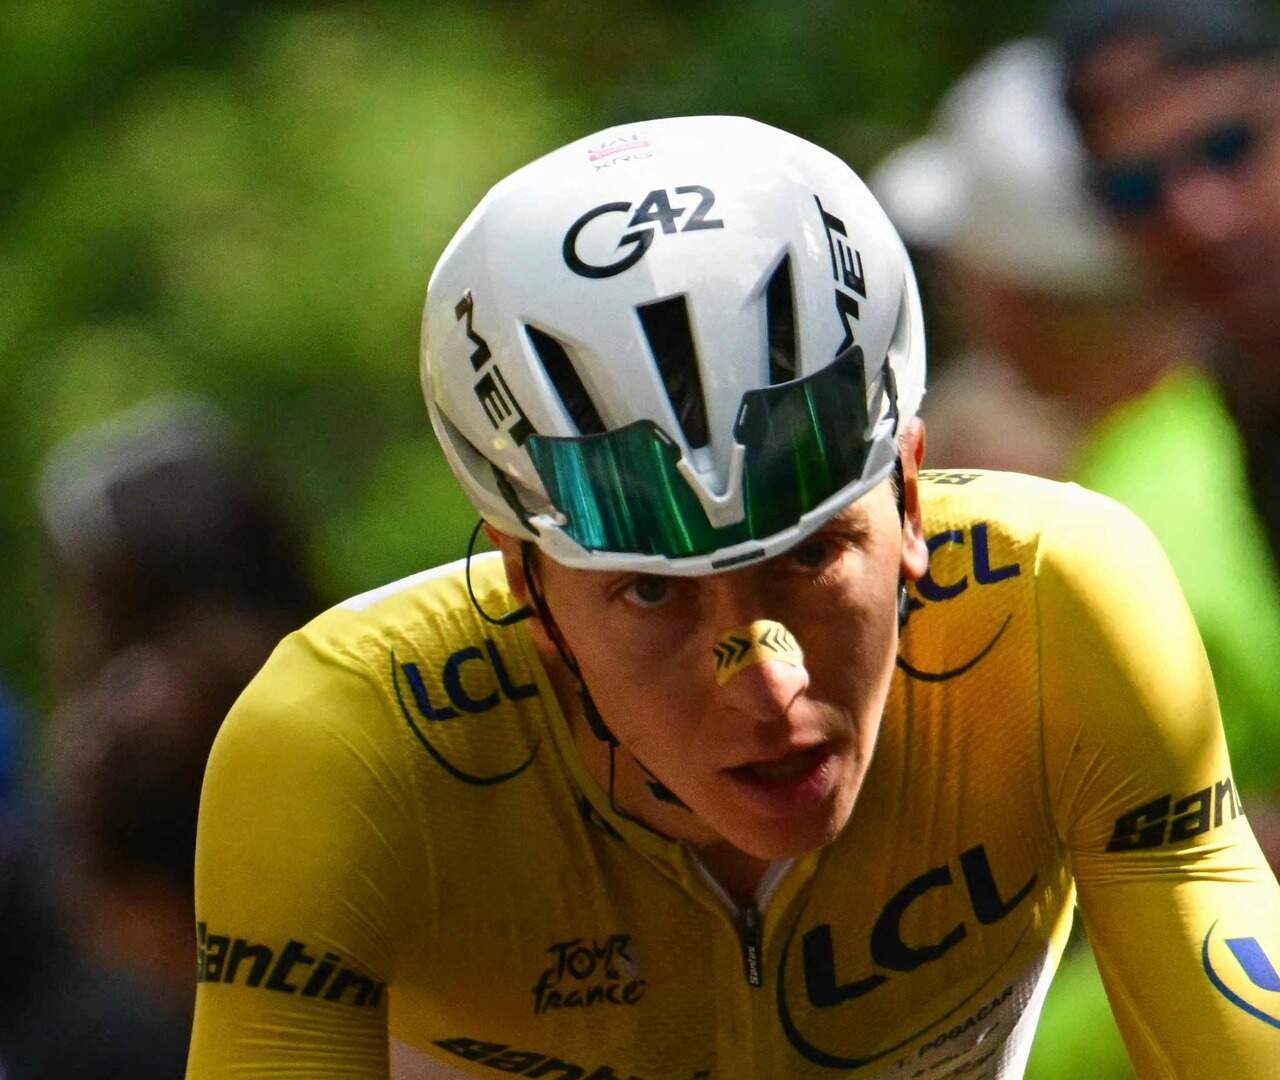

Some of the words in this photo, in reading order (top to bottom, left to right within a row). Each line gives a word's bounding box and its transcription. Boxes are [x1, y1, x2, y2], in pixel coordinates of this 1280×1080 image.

[562, 184, 725, 279] G42
[813, 194, 867, 358] MET
[454, 288, 538, 447] MET
[909, 523, 1020, 608] CL
[401, 637, 540, 722] LCL
[803, 843, 1038, 1008] LCL
